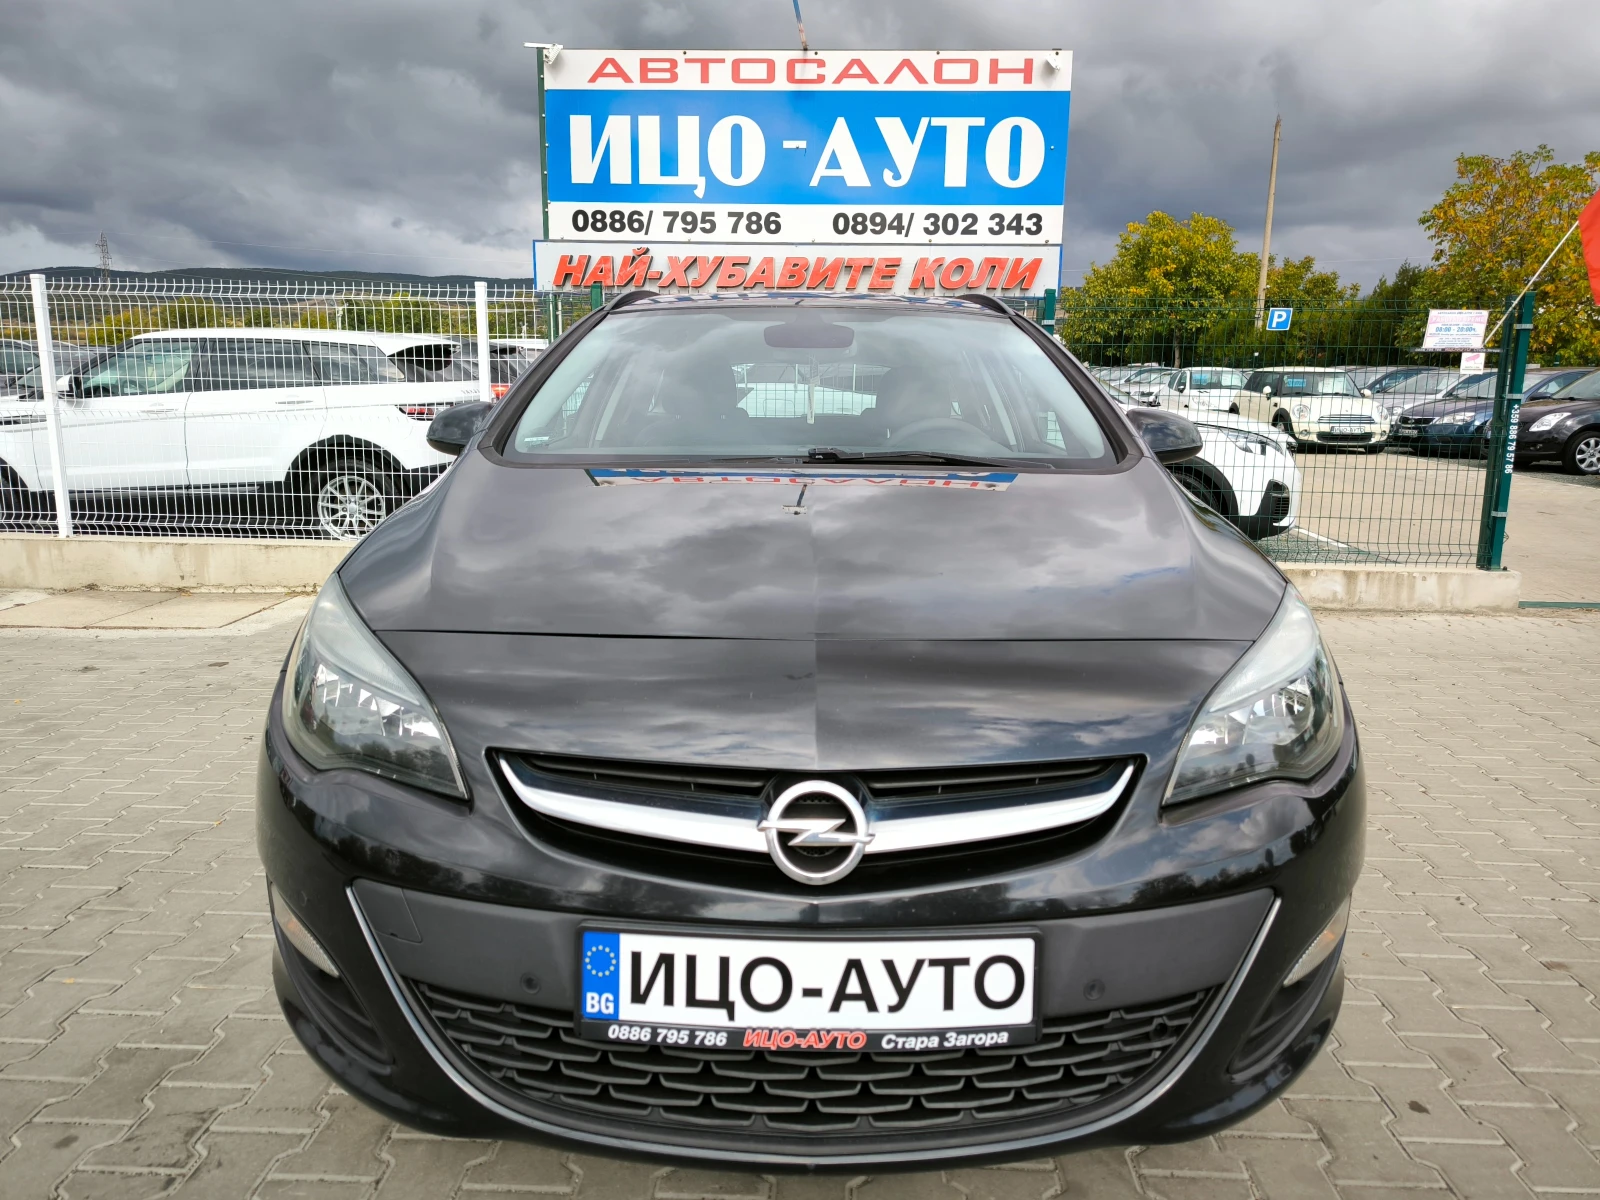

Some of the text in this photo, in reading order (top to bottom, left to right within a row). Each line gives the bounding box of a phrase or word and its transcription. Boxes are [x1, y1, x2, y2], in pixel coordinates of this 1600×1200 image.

[587, 57, 1034, 85] АВТОСАЛОН
[572, 209, 782, 236] 0886/ 795 786
[832, 212, 1043, 238] 0894/ 302 343
[553, 247, 1044, 290] НАЙ-ХУБАВИТЕ КОЛИ
[1271, 310, 1287, 328] P
[1504, 403, 1520, 474] +359 886 79 57 86
[630, 950, 1026, 1022] ИЦО-АУТО
[585, 991, 615, 1015] BG
[607, 1024, 1009, 1051] 0886 795 786 ИЦО-АУТО Стара Загора
